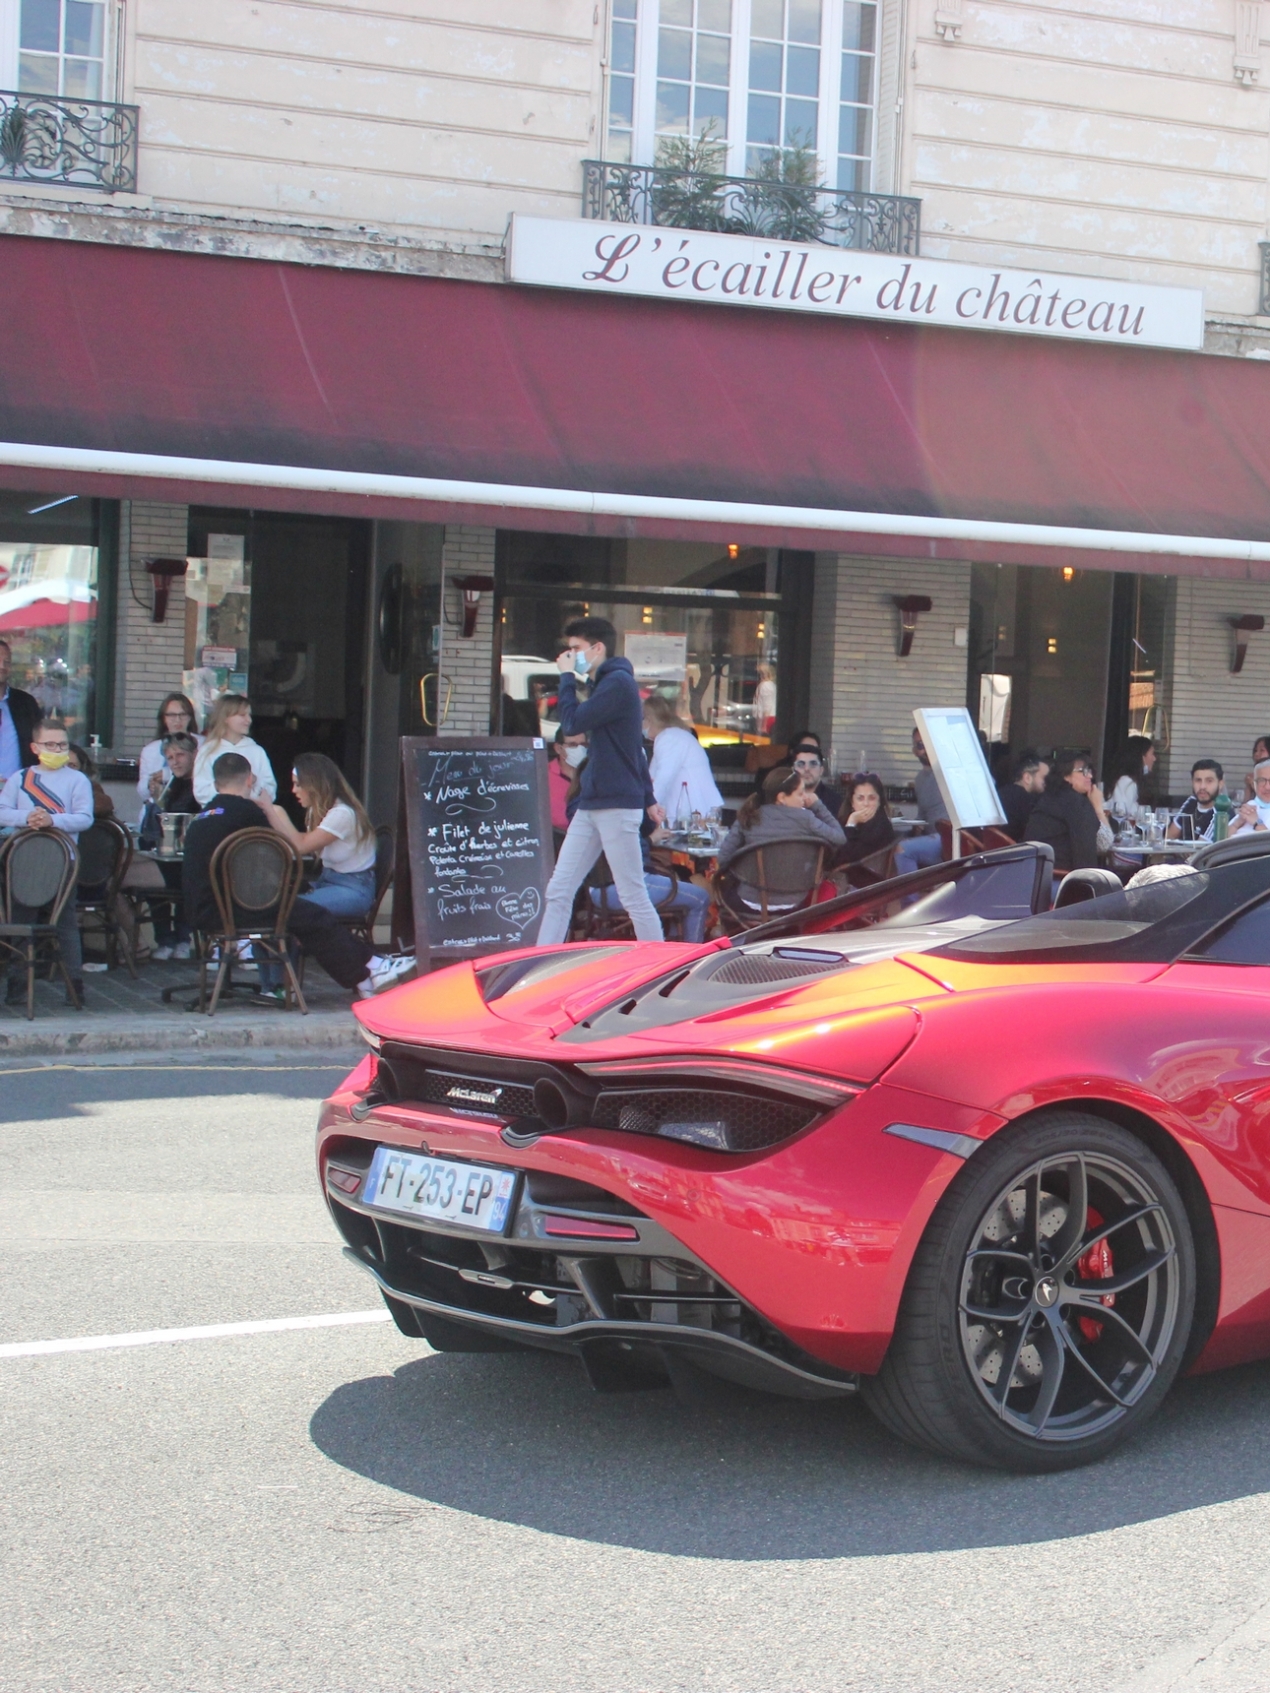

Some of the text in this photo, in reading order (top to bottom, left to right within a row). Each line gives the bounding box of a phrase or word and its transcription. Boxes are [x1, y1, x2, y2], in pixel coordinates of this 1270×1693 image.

[582, 233, 1146, 335] L'écailler du château
[468, 761, 482, 776] du
[488, 761, 514, 779] jour
[436, 785, 471, 804] Nage
[442, 819, 529, 840] Filet de julienne
[501, 837, 513, 848] et
[495, 850, 504, 860] et
[438, 884, 485, 897] Salade
[437, 896, 491, 921] fruits frais
[447, 1087, 496, 1104] McLaren
[380, 1155, 494, 1216] FT-253-EP
